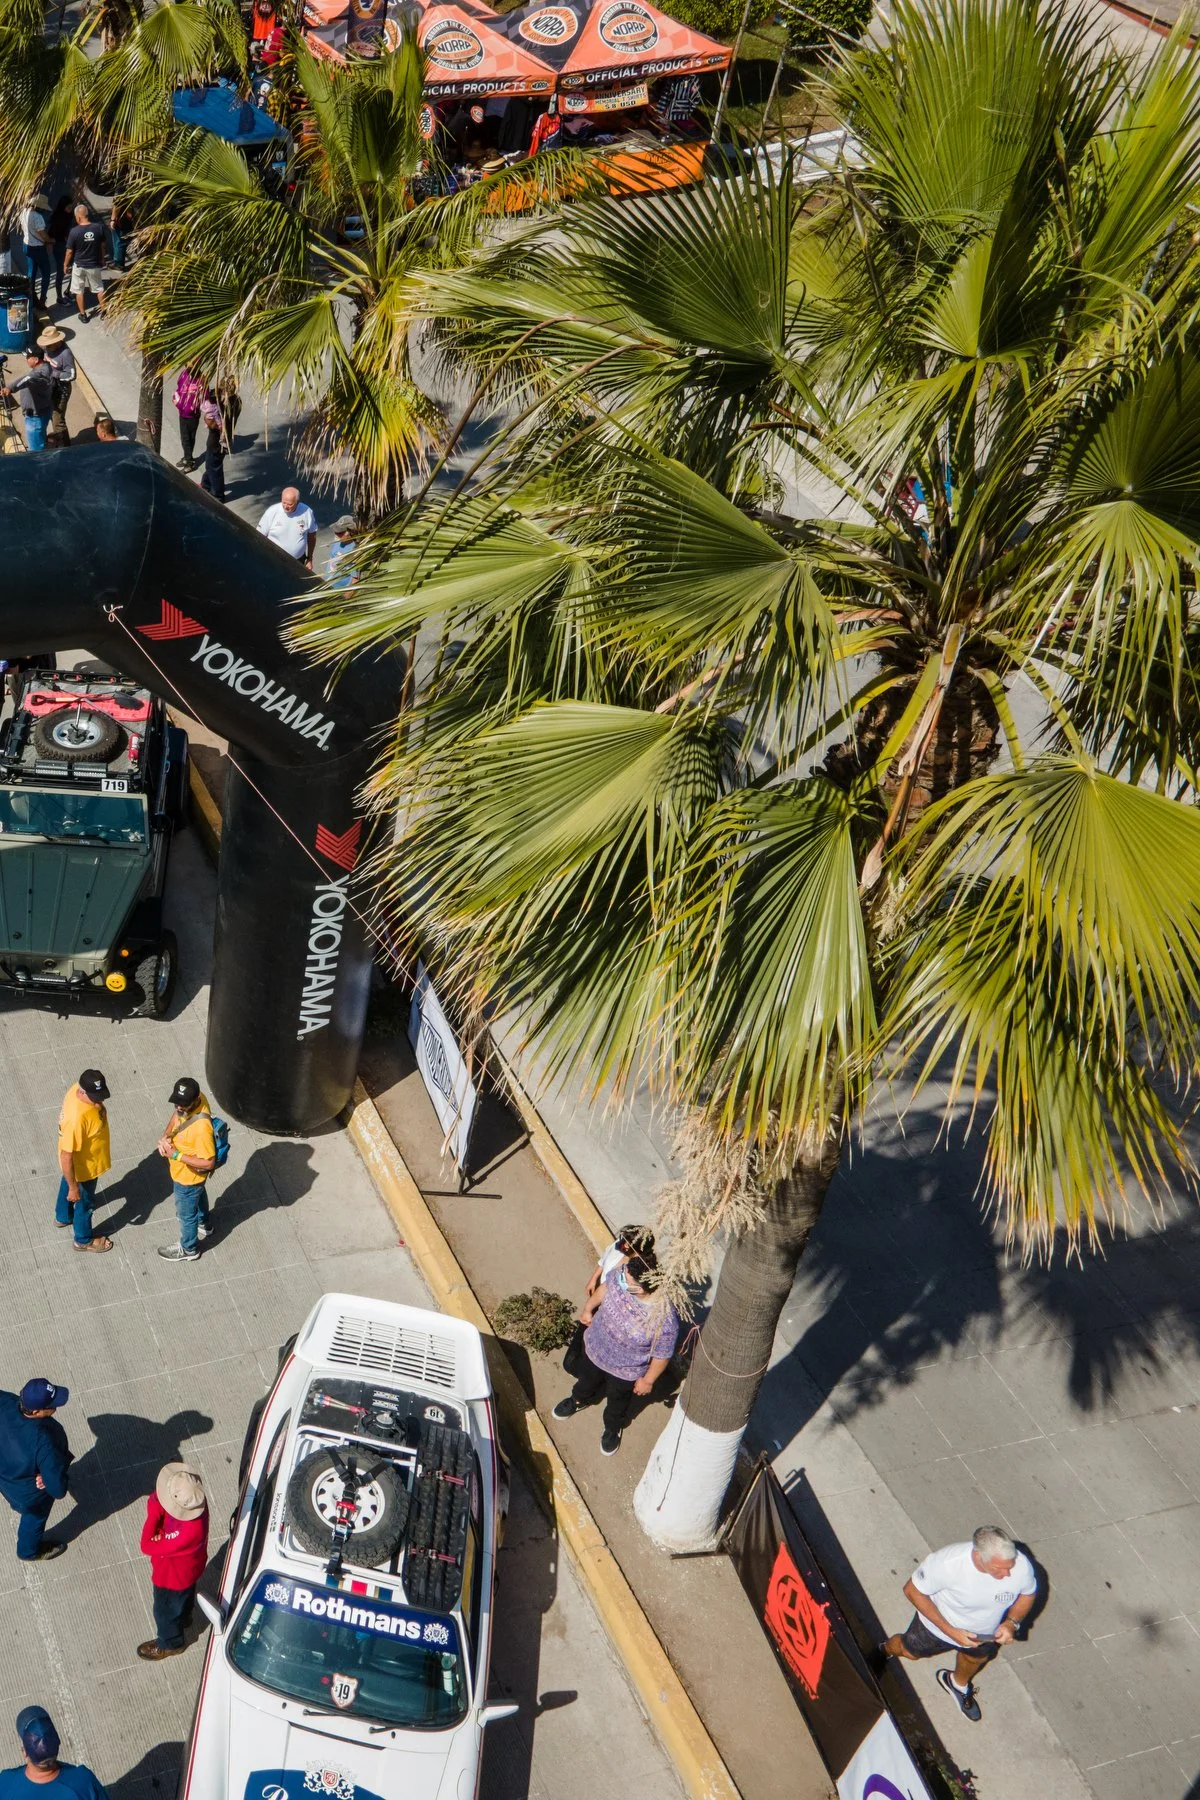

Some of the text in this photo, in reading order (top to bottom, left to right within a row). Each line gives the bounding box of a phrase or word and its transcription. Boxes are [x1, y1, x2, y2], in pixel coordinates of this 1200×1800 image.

[532, 15, 565, 37] NORRA
[612, 21, 646, 36] NORRA
[437, 39, 472, 53] NORRA
[586, 68, 638, 83] OFFICIAL
[641, 58, 702, 75] PRODUCTS
[421, 83, 459, 96] FICIAL
[462, 81, 526, 94] PRODUCTS
[190, 633, 337, 750] YOKOHAMA
[103, 780, 126, 792] 719
[300, 873, 350, 1036] YOKOHAMA
[292, 1586, 421, 1640] Rothmans
[337, 1682, 350, 1700] 19
